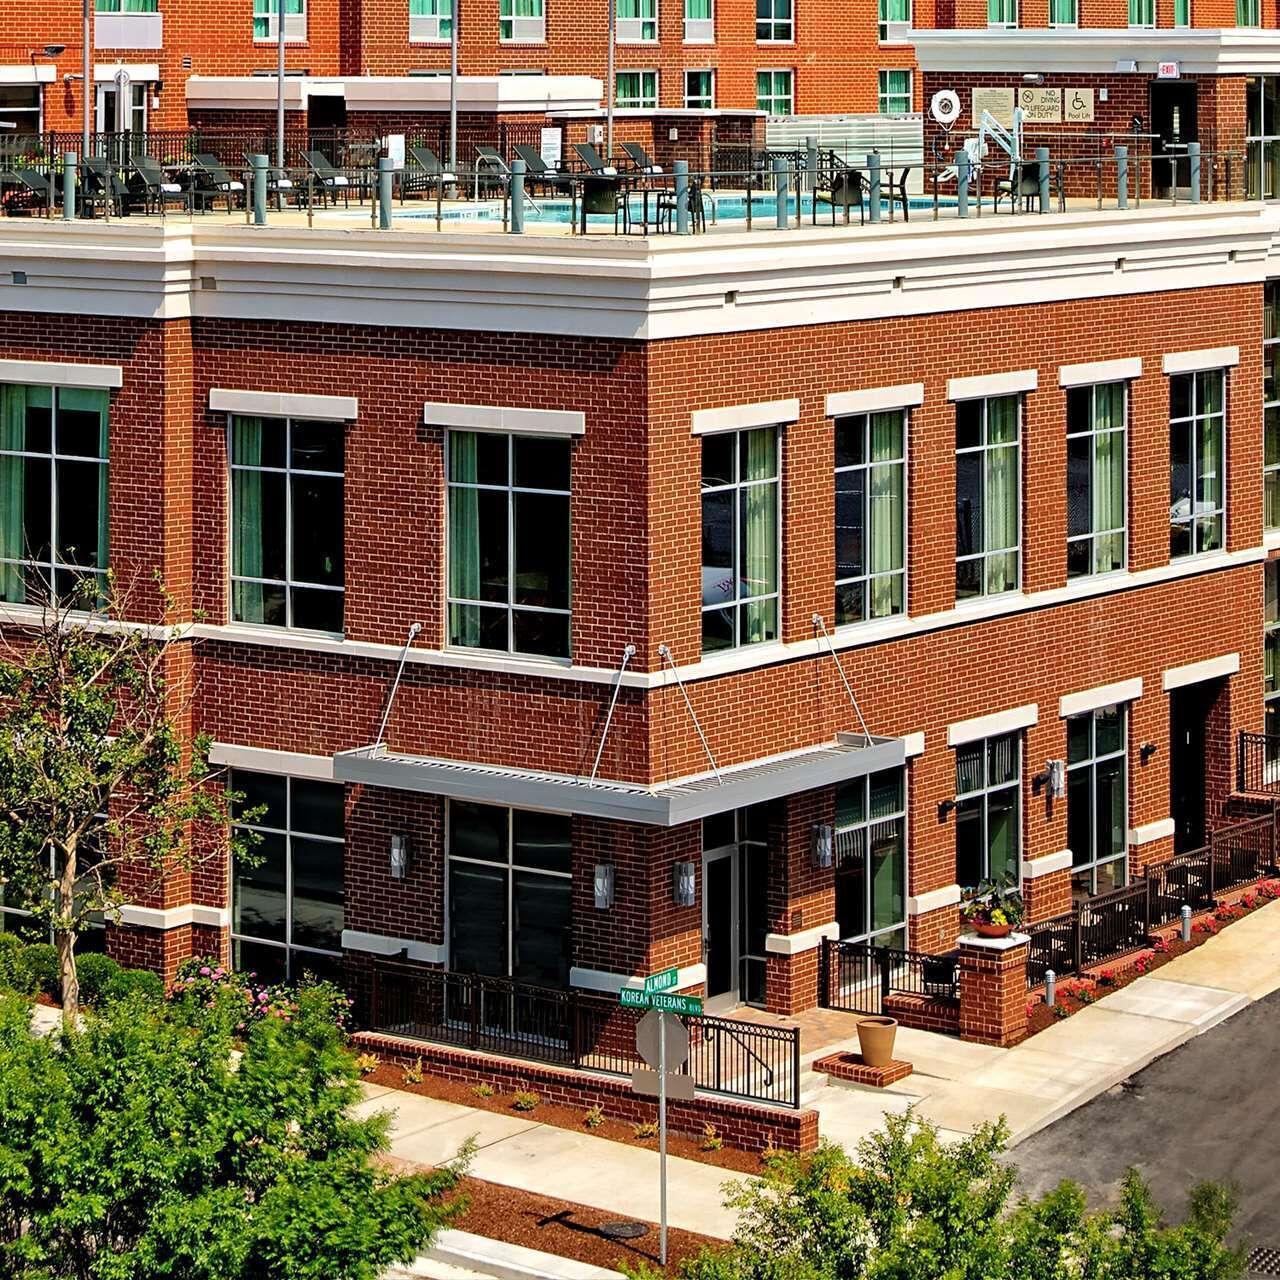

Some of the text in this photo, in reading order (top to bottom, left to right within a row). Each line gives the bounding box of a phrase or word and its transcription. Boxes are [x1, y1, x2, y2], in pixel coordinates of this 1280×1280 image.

[645, 972, 672, 994] ALMOND
[621, 990, 650, 1006] KOREAN
[651, 993, 686, 1010] VETERANS
